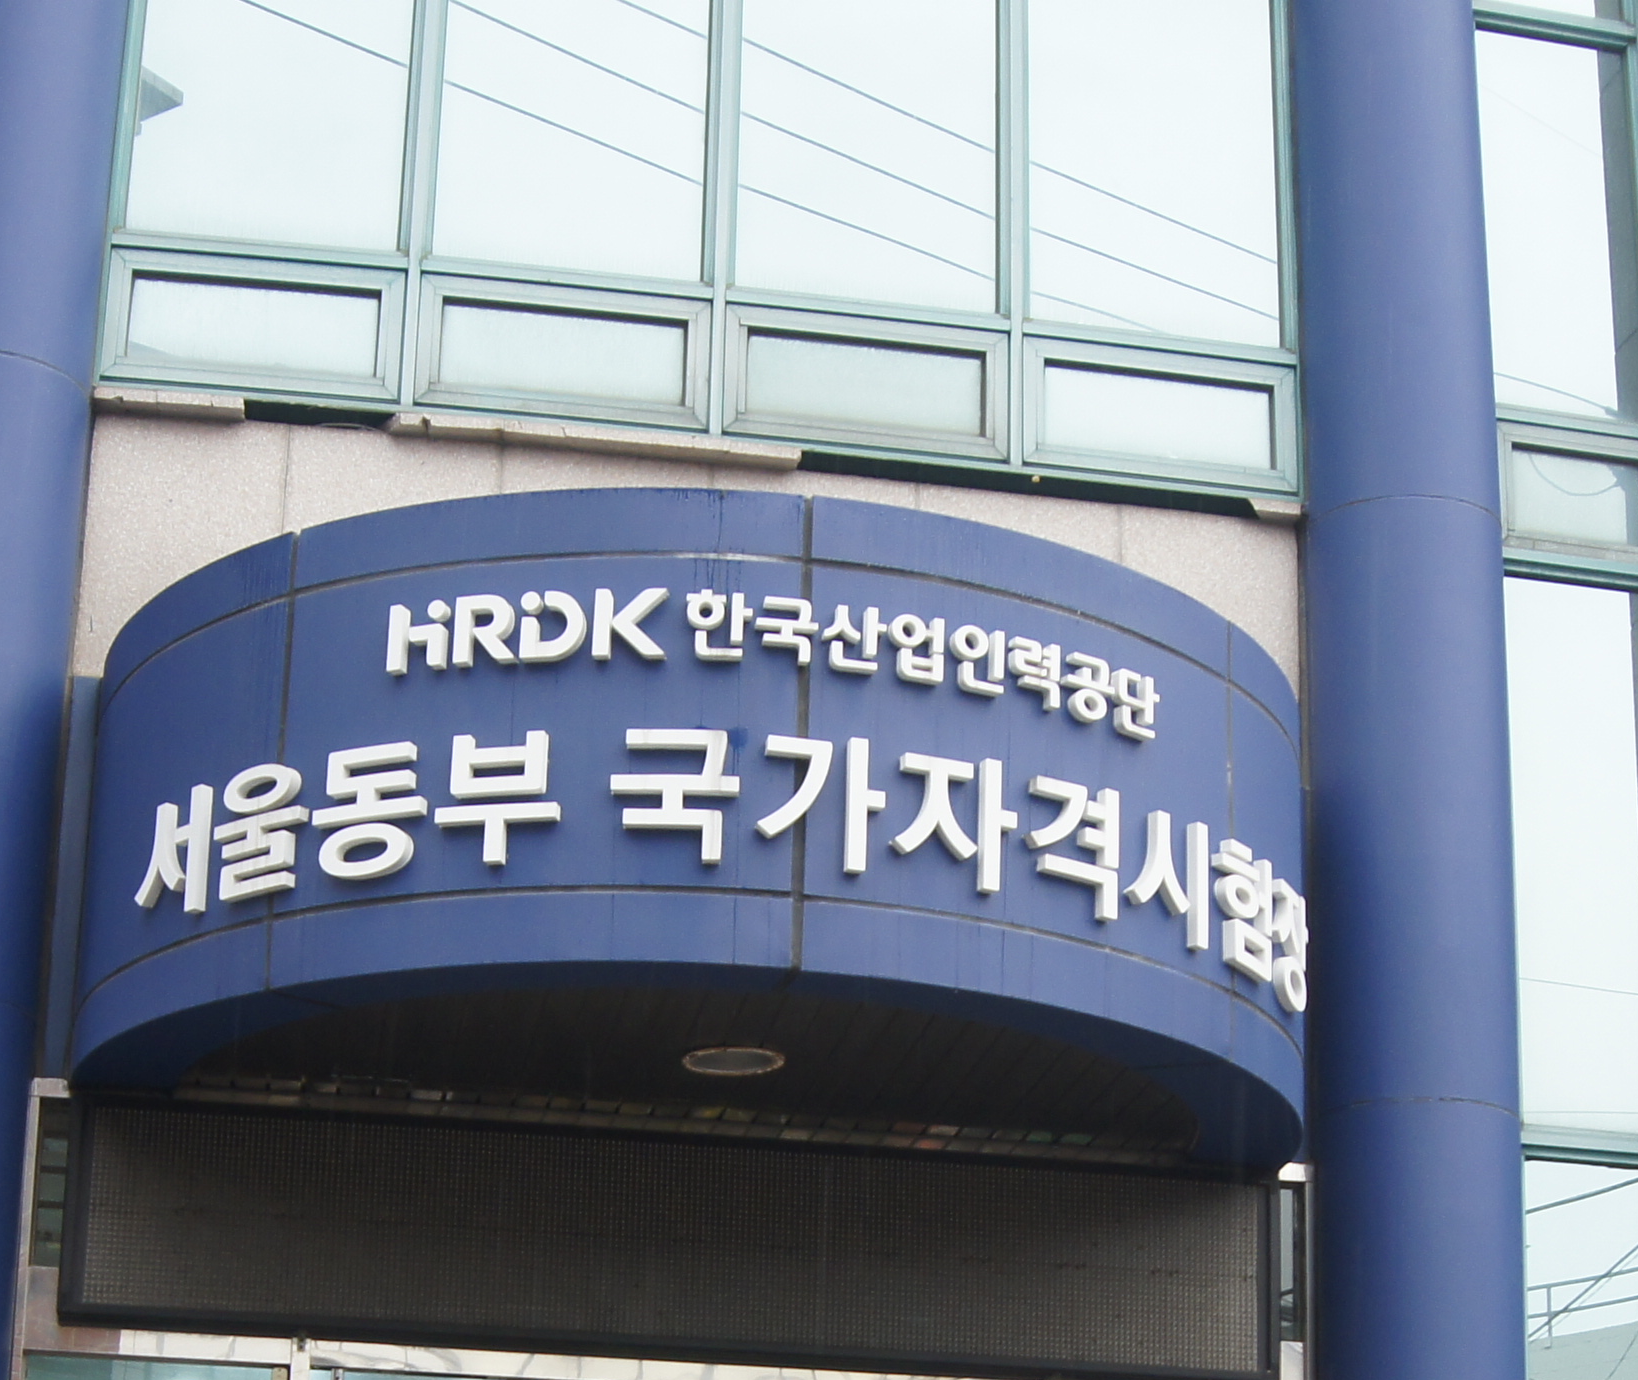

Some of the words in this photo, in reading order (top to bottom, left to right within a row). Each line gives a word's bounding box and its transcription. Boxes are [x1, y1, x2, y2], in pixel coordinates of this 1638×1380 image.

[685, 587, 1161, 742] 한국산업인력공단
[134, 729, 561, 915] 서울동부
[609, 727, 1309, 1014] 국가자격시험장
